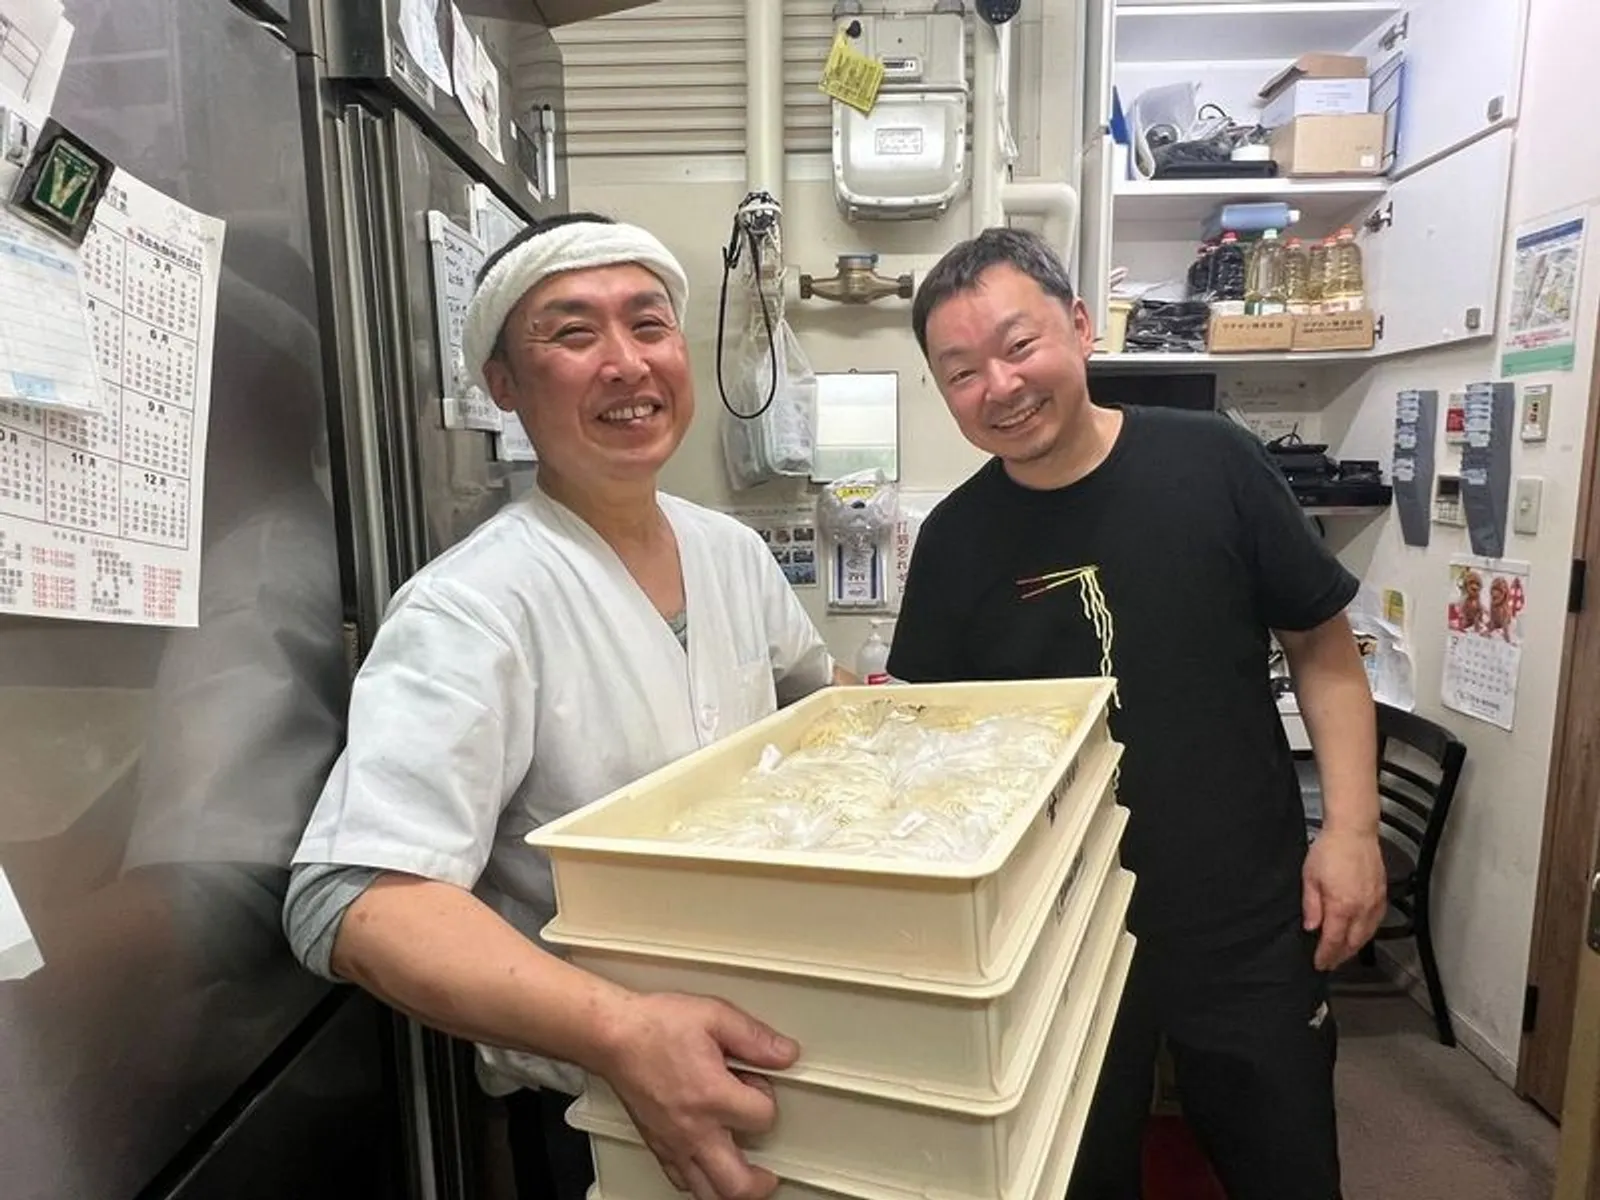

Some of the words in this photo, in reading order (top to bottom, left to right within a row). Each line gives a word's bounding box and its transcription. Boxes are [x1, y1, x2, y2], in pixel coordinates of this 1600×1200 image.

[153, 257, 172, 274] 3月
[150, 328, 169, 344] 6月
[148, 400, 165, 415] 9月
[71, 452, 96, 468] 11月
[144, 472, 167, 486] 12月
